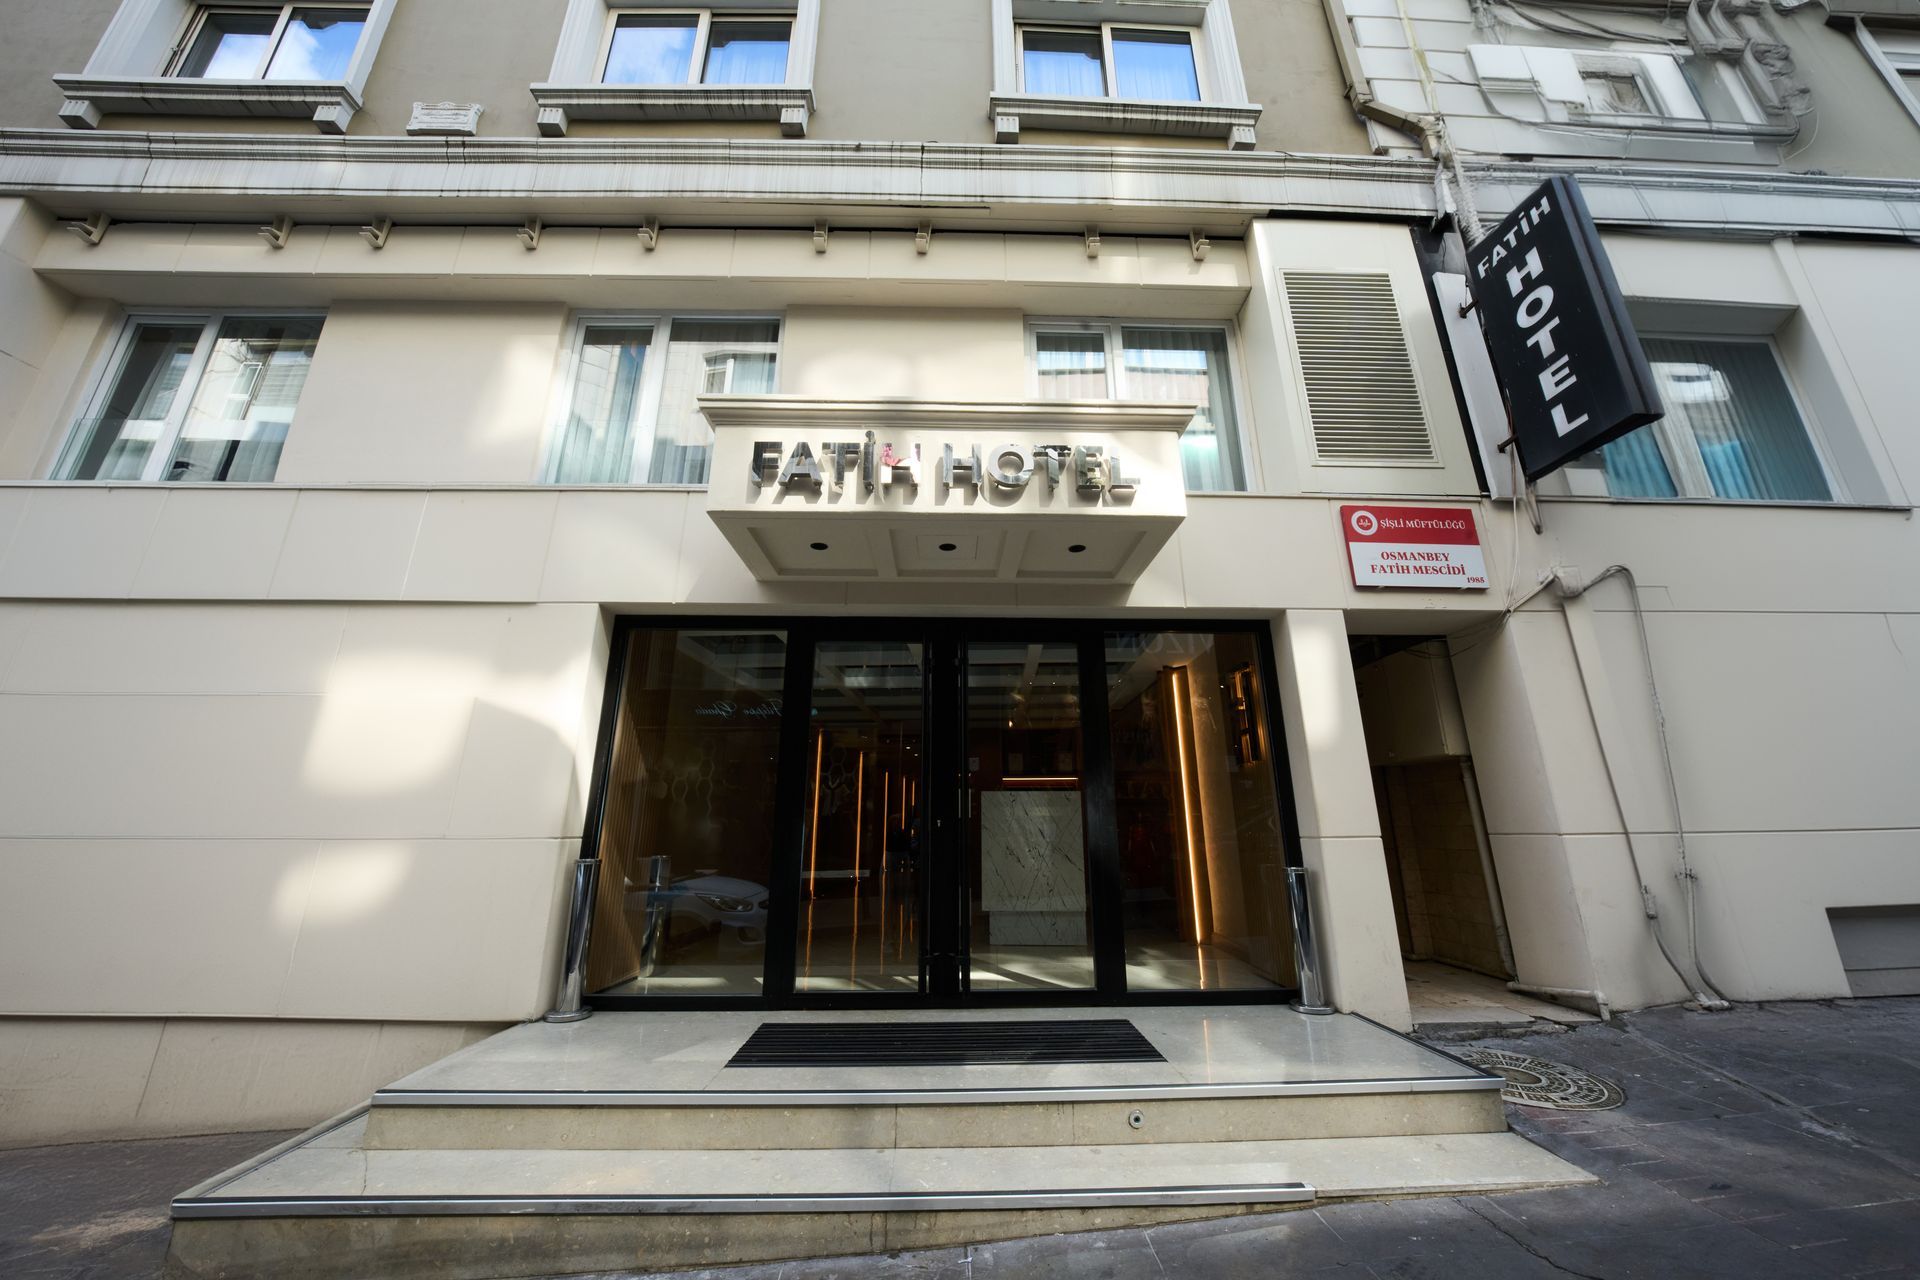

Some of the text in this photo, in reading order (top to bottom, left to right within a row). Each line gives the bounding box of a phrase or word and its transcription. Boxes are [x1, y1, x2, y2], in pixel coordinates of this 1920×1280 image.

[1478, 195, 1589, 438] FATİH HOTEL
[751, 430, 1142, 493] FATİH HOTEL
[1380, 518, 1404, 529] ŞİŞLİ
[1406, 519, 1466, 530] MÜFTÜLÜĞÜ
[1381, 551, 1450, 562] OSMANBEY
[1371, 563, 1466, 576] FATİH MESCİDİ
